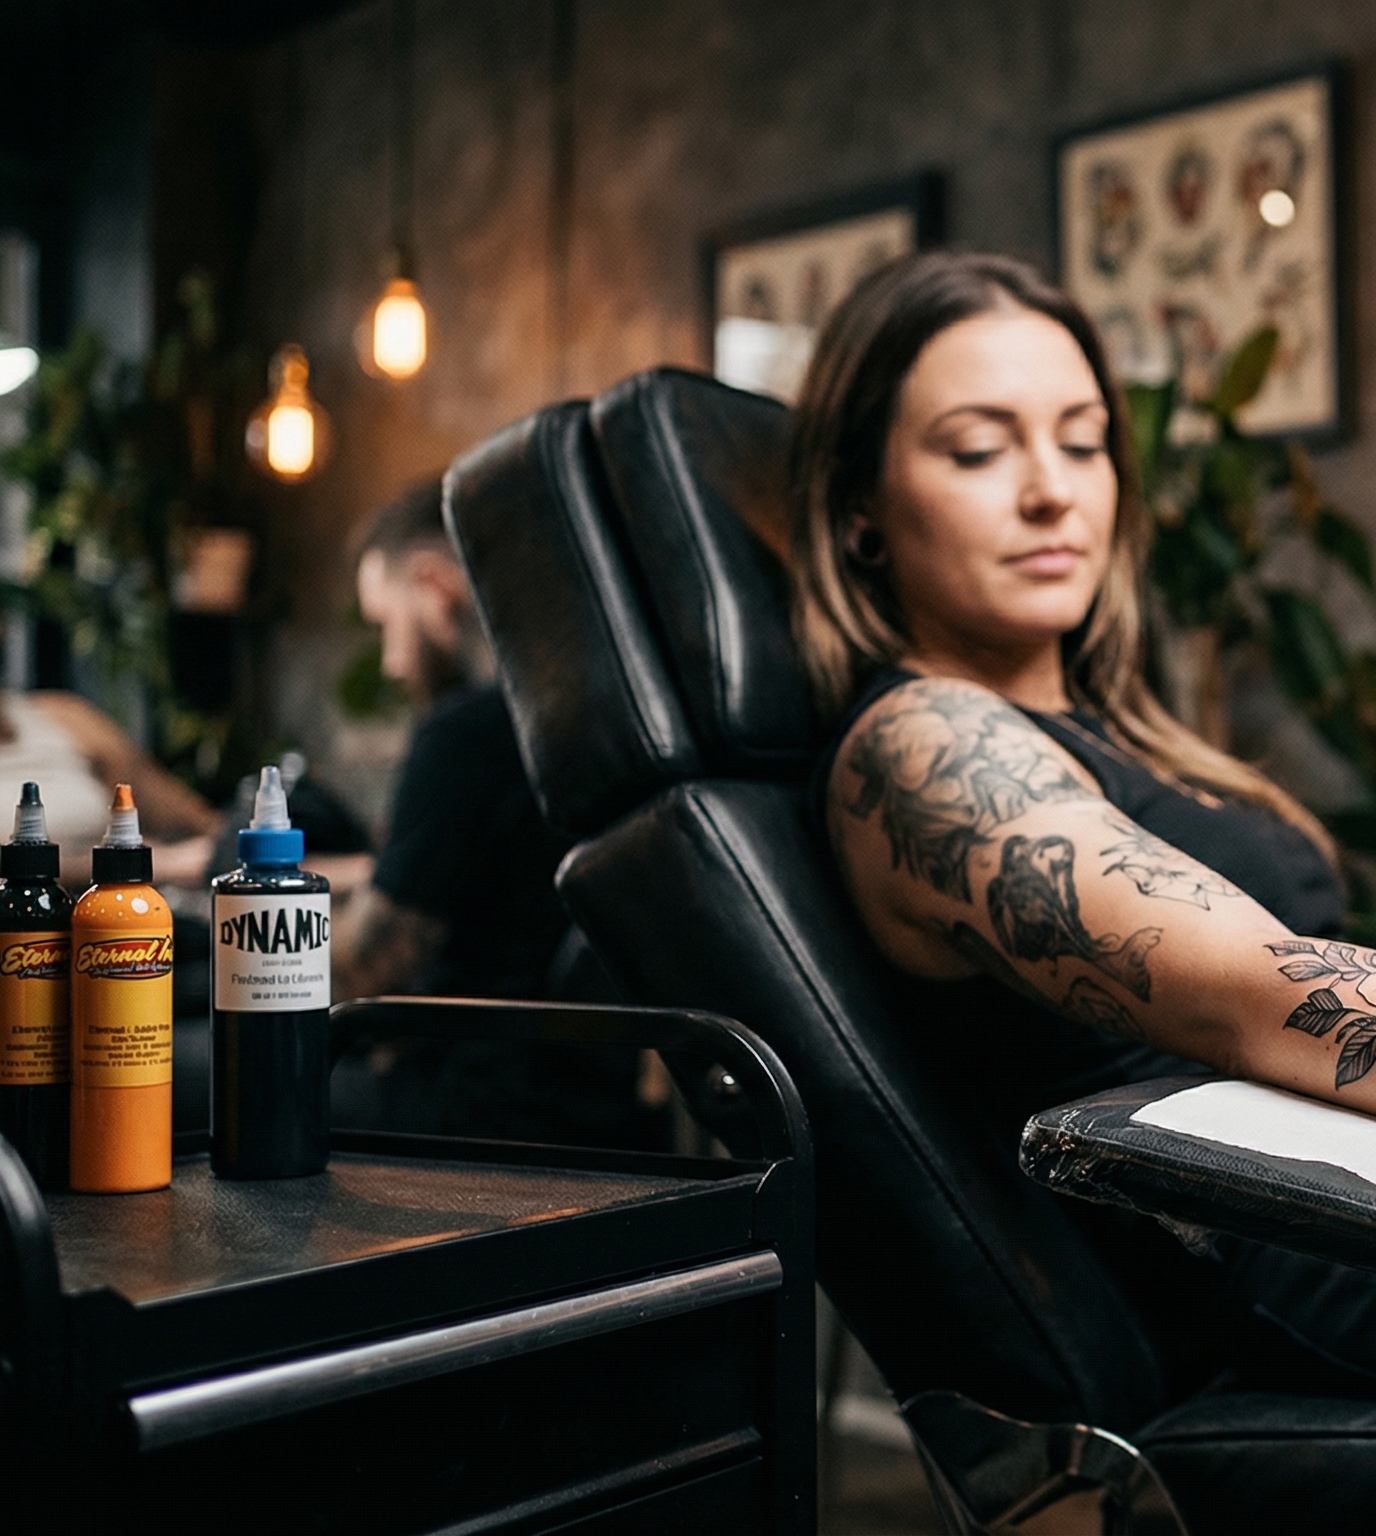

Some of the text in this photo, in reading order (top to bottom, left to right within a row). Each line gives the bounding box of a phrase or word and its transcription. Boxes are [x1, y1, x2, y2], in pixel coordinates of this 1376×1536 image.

[220, 907, 329, 954] DYNAMIC
[1, 946, 68, 973] Etern
[77, 939, 156, 972] Eternal
